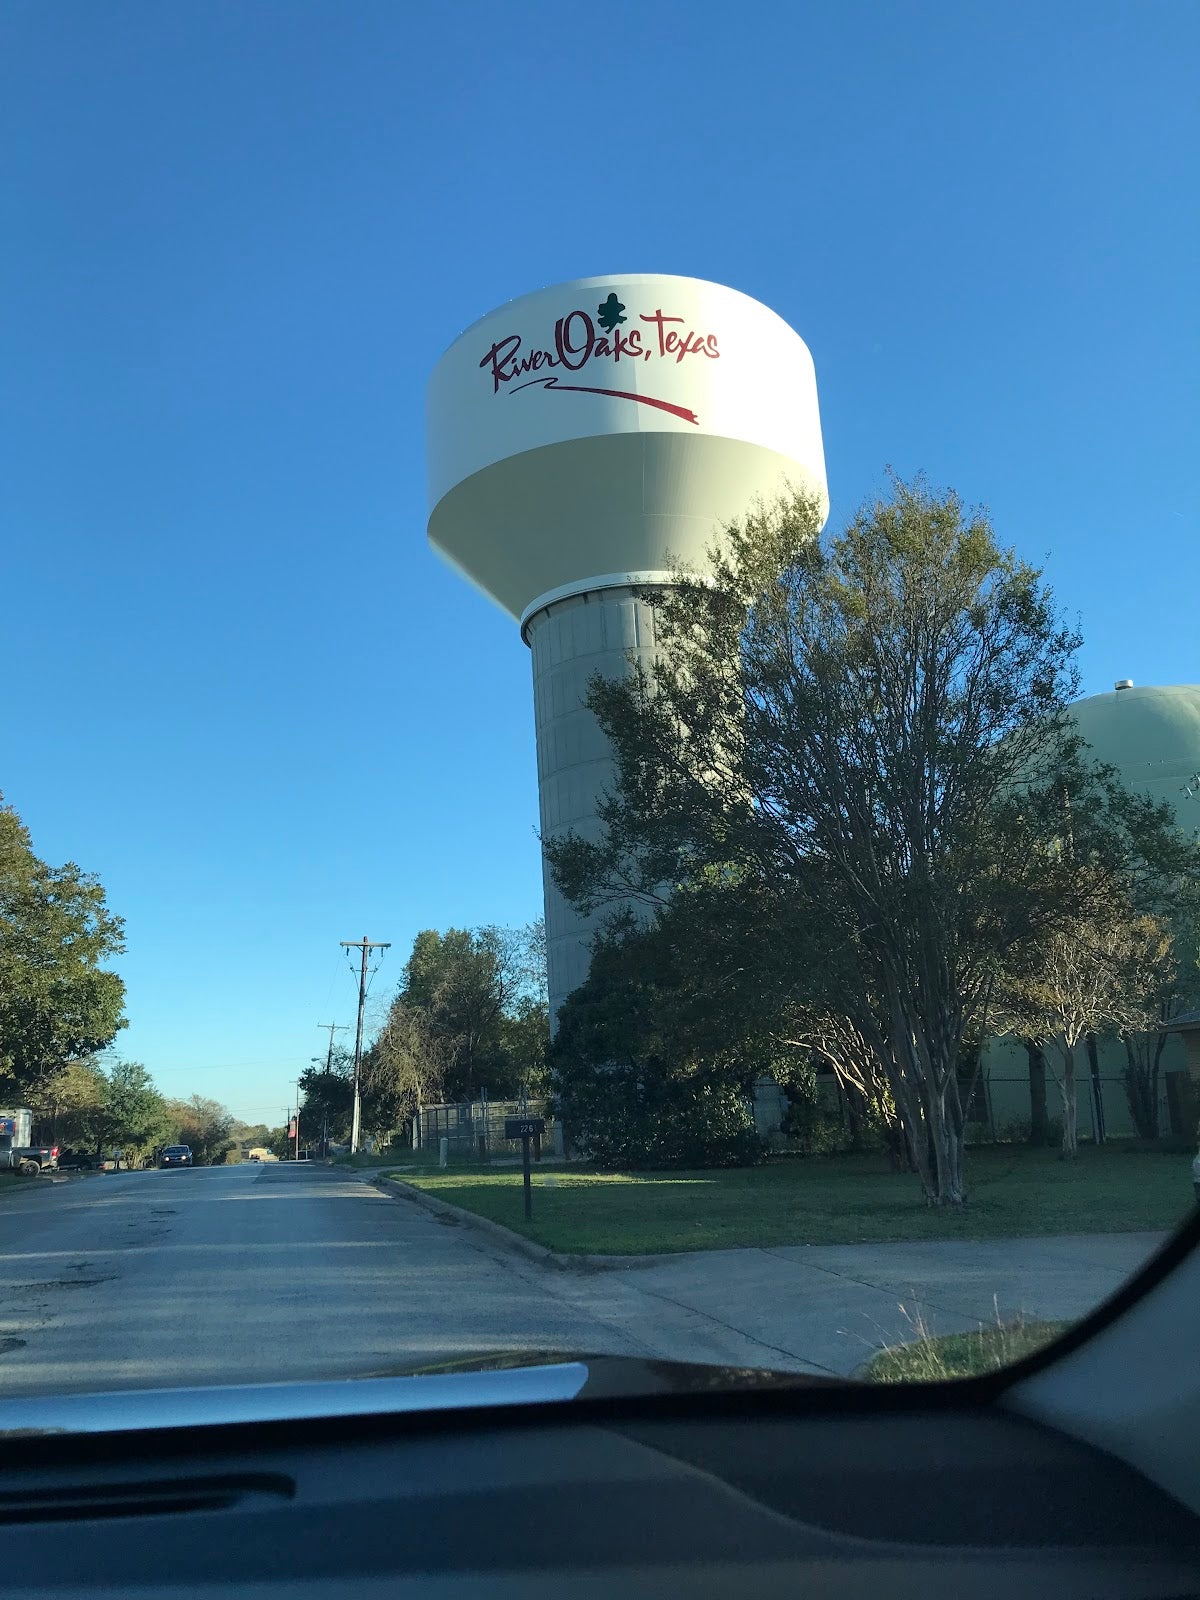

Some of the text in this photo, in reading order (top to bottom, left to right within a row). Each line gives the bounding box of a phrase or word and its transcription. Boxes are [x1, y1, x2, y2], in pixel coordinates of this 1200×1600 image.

[480, 309, 720, 394] River Oaks, Texas
